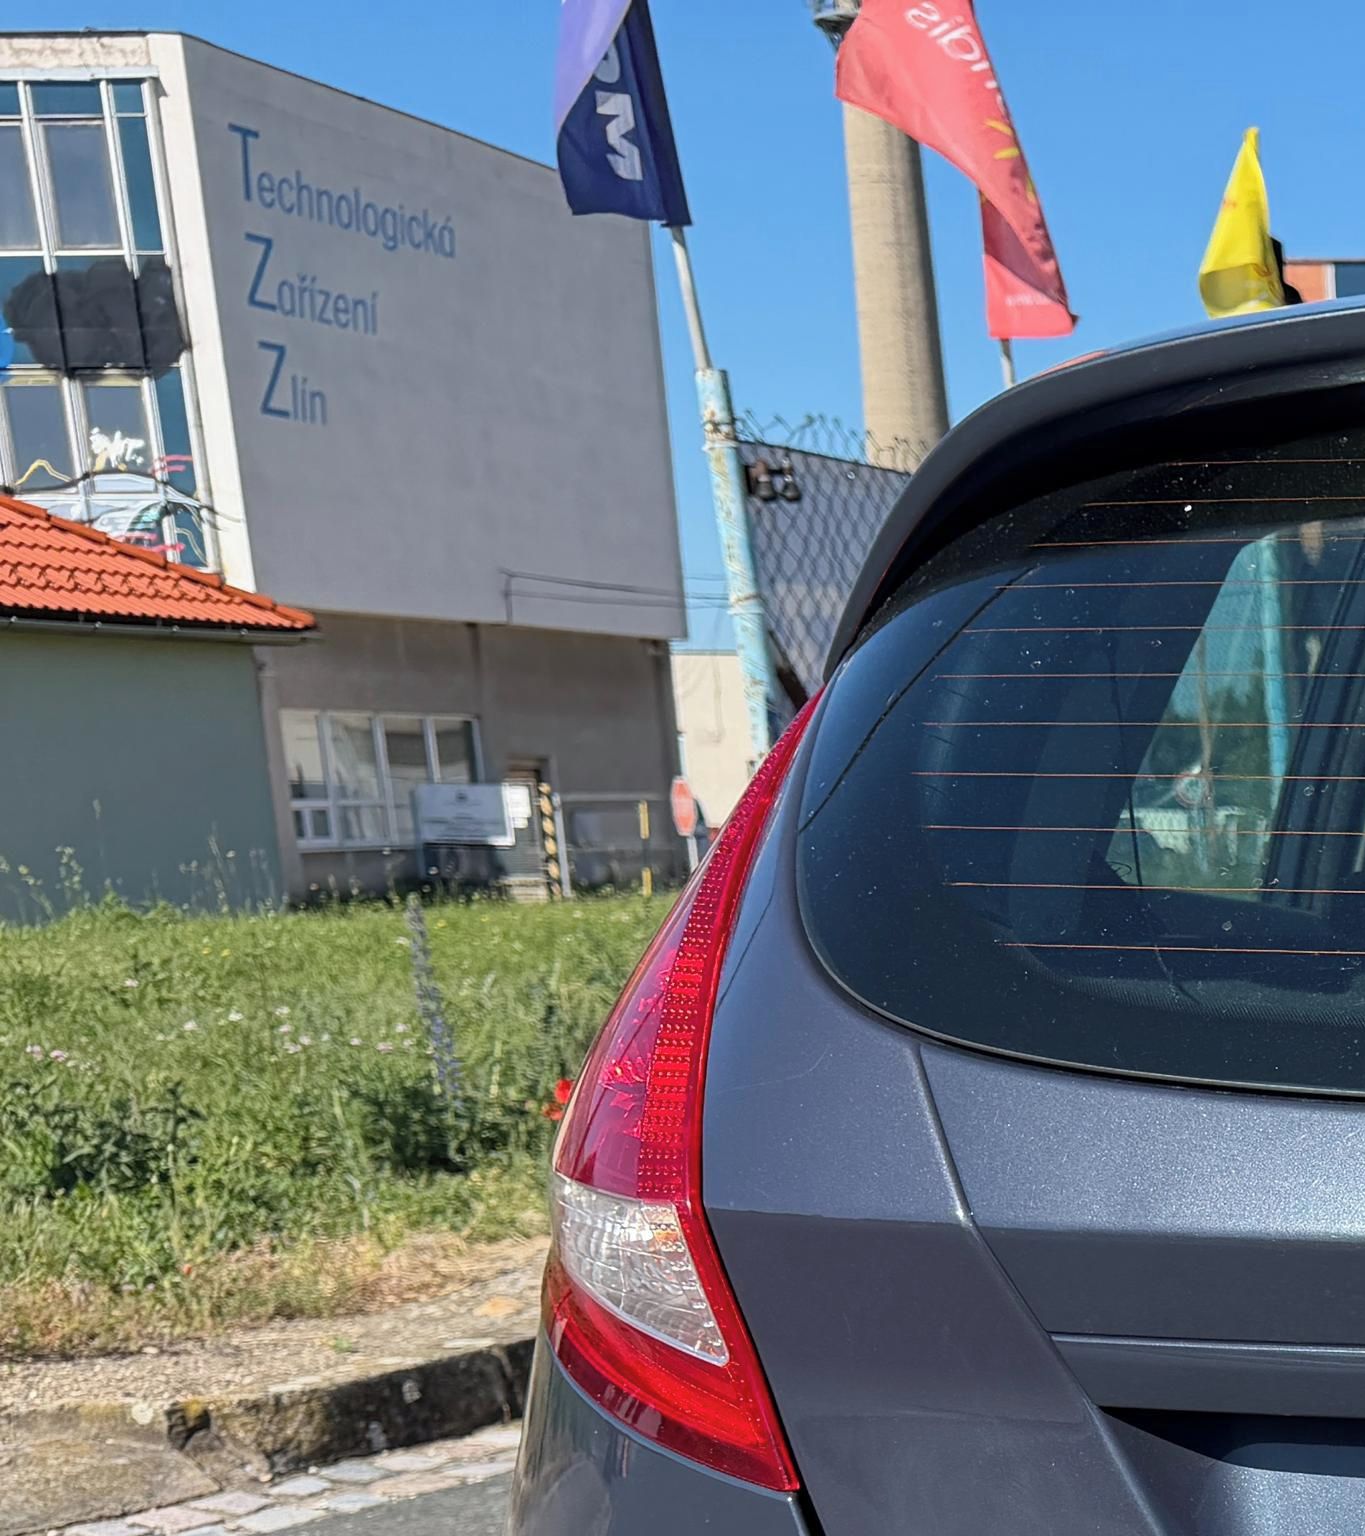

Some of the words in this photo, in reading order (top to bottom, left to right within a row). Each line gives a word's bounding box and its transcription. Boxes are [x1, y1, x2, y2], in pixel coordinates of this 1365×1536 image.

[228, 122, 456, 258] Technologická
[244, 232, 379, 335] Zařízení
[257, 340, 328, 426] Zlín
